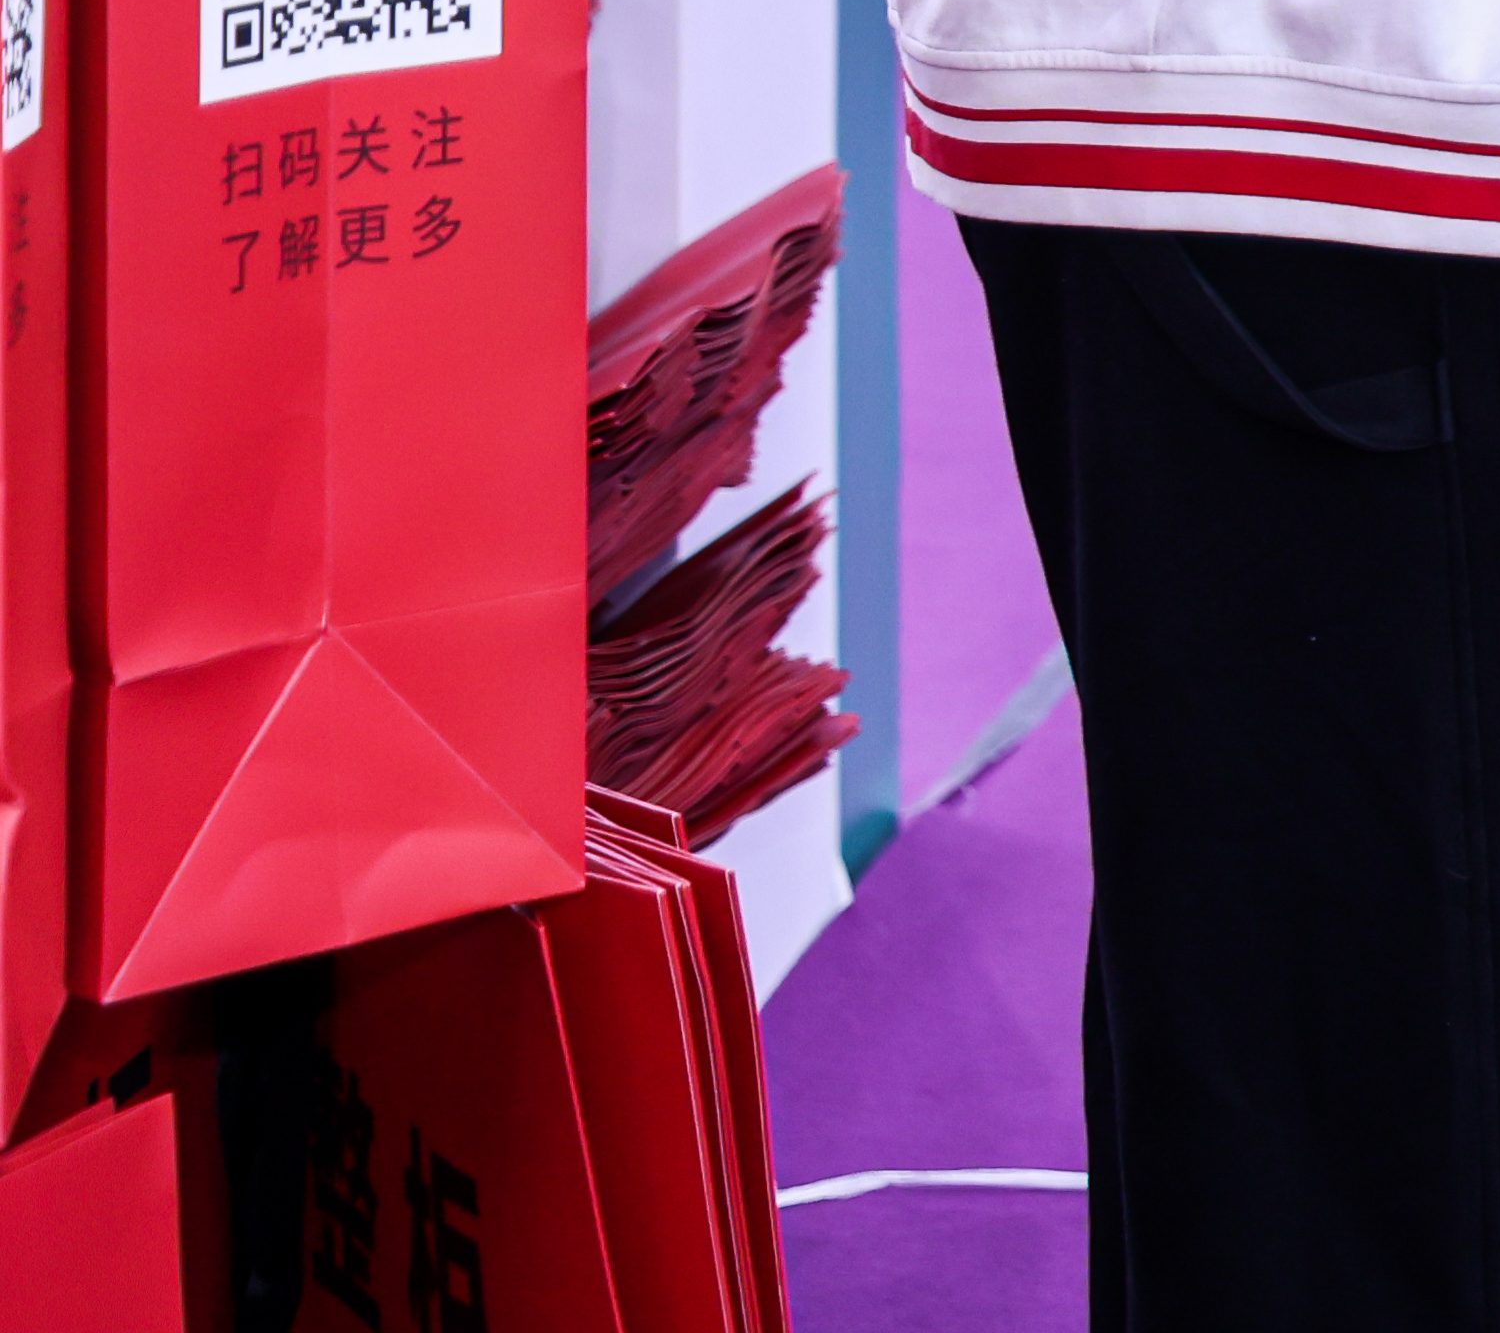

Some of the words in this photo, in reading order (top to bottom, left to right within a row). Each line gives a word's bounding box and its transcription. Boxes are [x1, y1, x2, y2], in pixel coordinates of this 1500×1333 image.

[220, 105, 466, 207] 扫码关注
[220, 195, 464, 295] 了解更多
